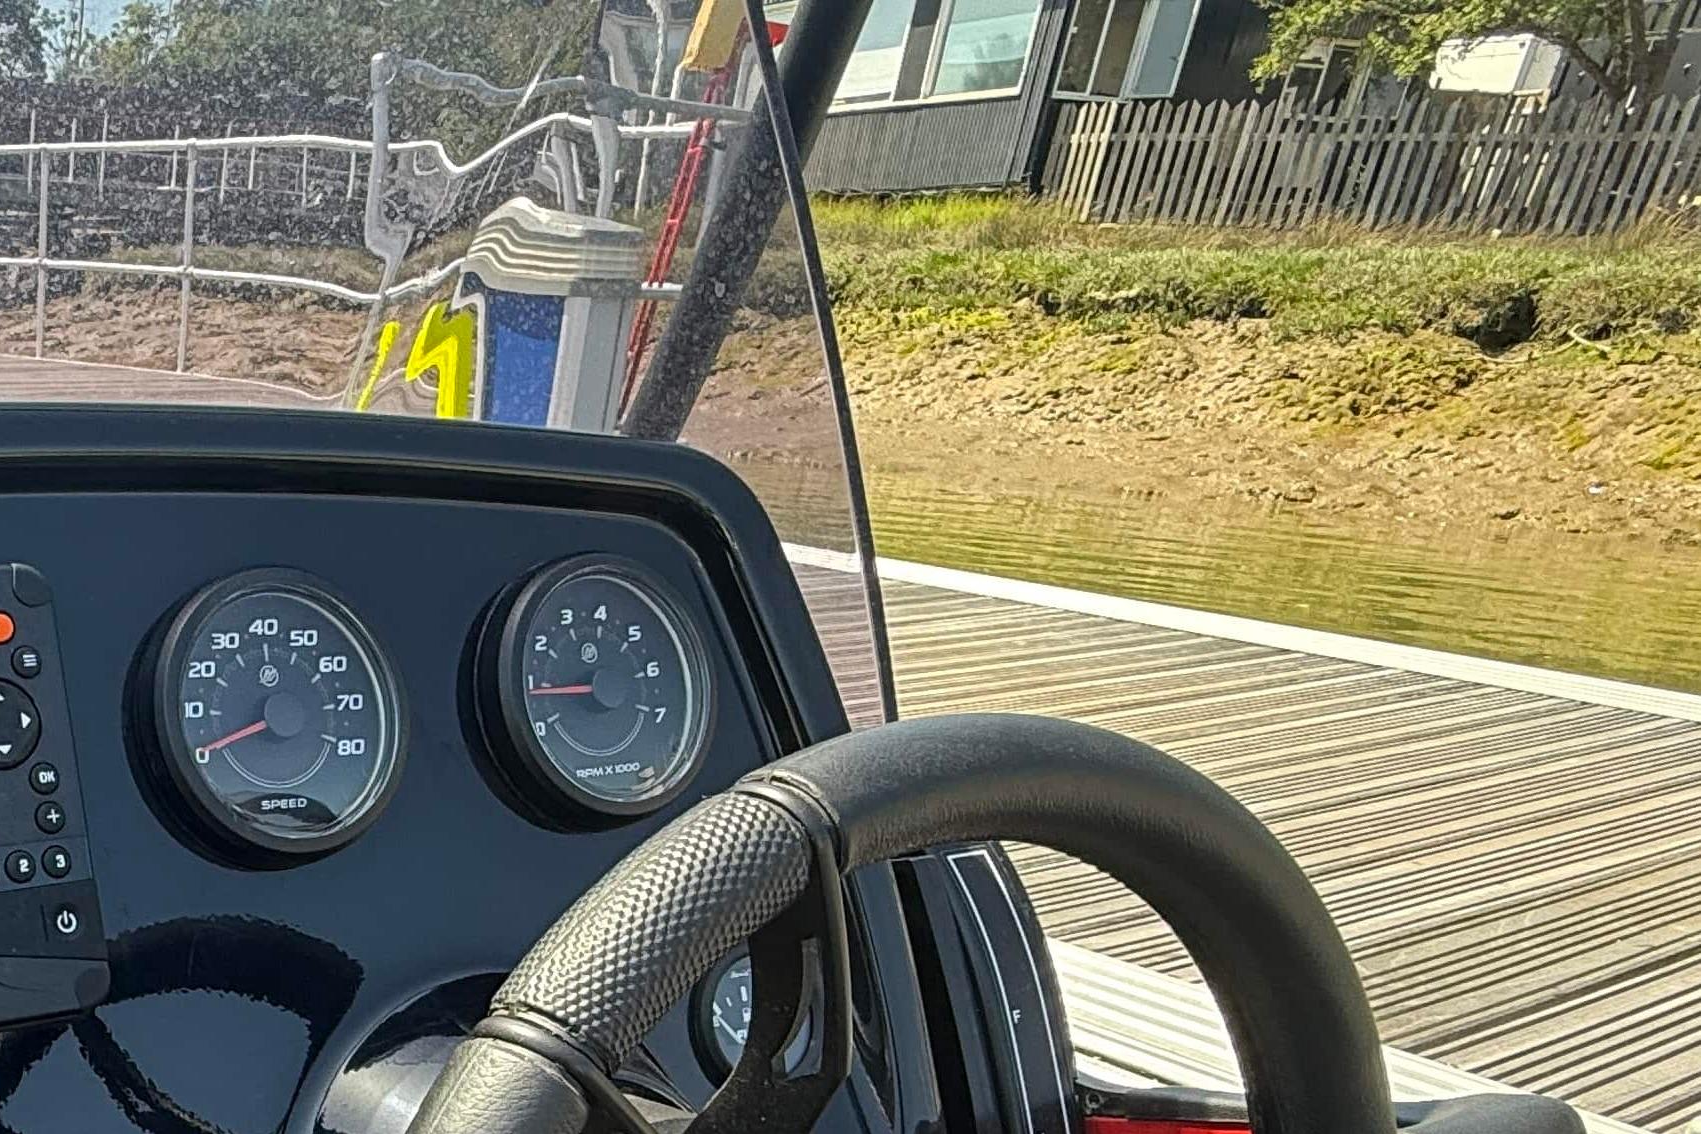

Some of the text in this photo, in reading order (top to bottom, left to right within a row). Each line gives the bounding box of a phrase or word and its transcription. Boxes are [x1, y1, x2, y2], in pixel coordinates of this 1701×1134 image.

[560, 608, 573, 625] 3
[593, 605, 608, 621] 4
[249, 618, 279, 636] 40
[628, 625, 642, 642] 5
[211, 632, 240, 649] 30
[289, 630, 318, 646] 50
[534, 635, 548, 651] 2
[188, 661, 216, 678] 20
[319, 656, 347, 672] 60
[646, 661, 660, 677] 6
[527, 675, 534, 690] 1
[184, 702, 204, 718] 10
[336, 694, 363, 711] 70
[654, 707, 667, 723] 7
[337, 738, 365, 756] 80
[195, 747, 210, 764] 0
[38, 770, 56, 784] OK
[576, 767, 603, 778] RPM
[614, 762, 640, 774] 1000
[260, 798, 307, 810] SPEED
[19, 858, 30, 873] 2
[55, 854, 66, 868] 3
[1012, 1009, 1021, 1024] F
